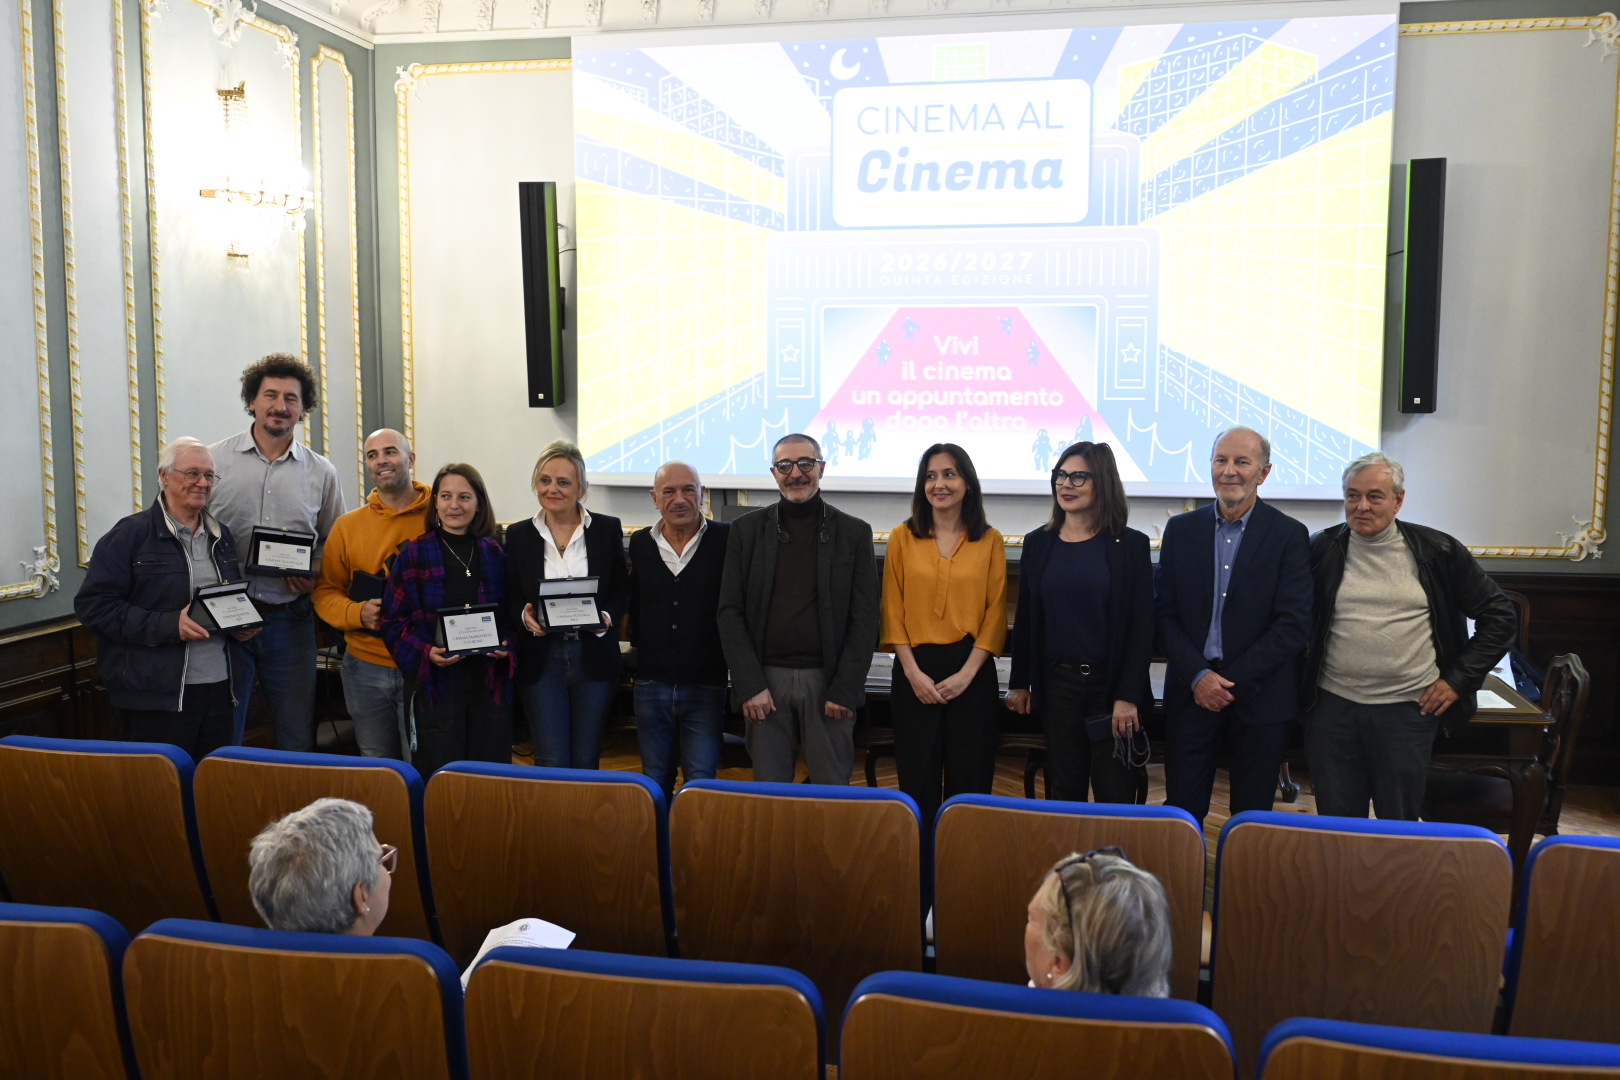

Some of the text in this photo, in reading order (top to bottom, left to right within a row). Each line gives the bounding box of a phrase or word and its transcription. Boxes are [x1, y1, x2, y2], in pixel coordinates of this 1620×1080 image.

[857, 100, 1065, 135] CINEMA AL
[856, 146, 1064, 193] Cinema
[880, 251, 1034, 273] 2026/2027
[879, 273, 1034, 287] QUINTA EDIZIONE
[933, 335, 979, 356] Vivi
[901, 360, 1012, 381] il cinema
[851, 387, 1064, 410] un appuntamento
[886, 410, 1027, 433] dopo l'altro
